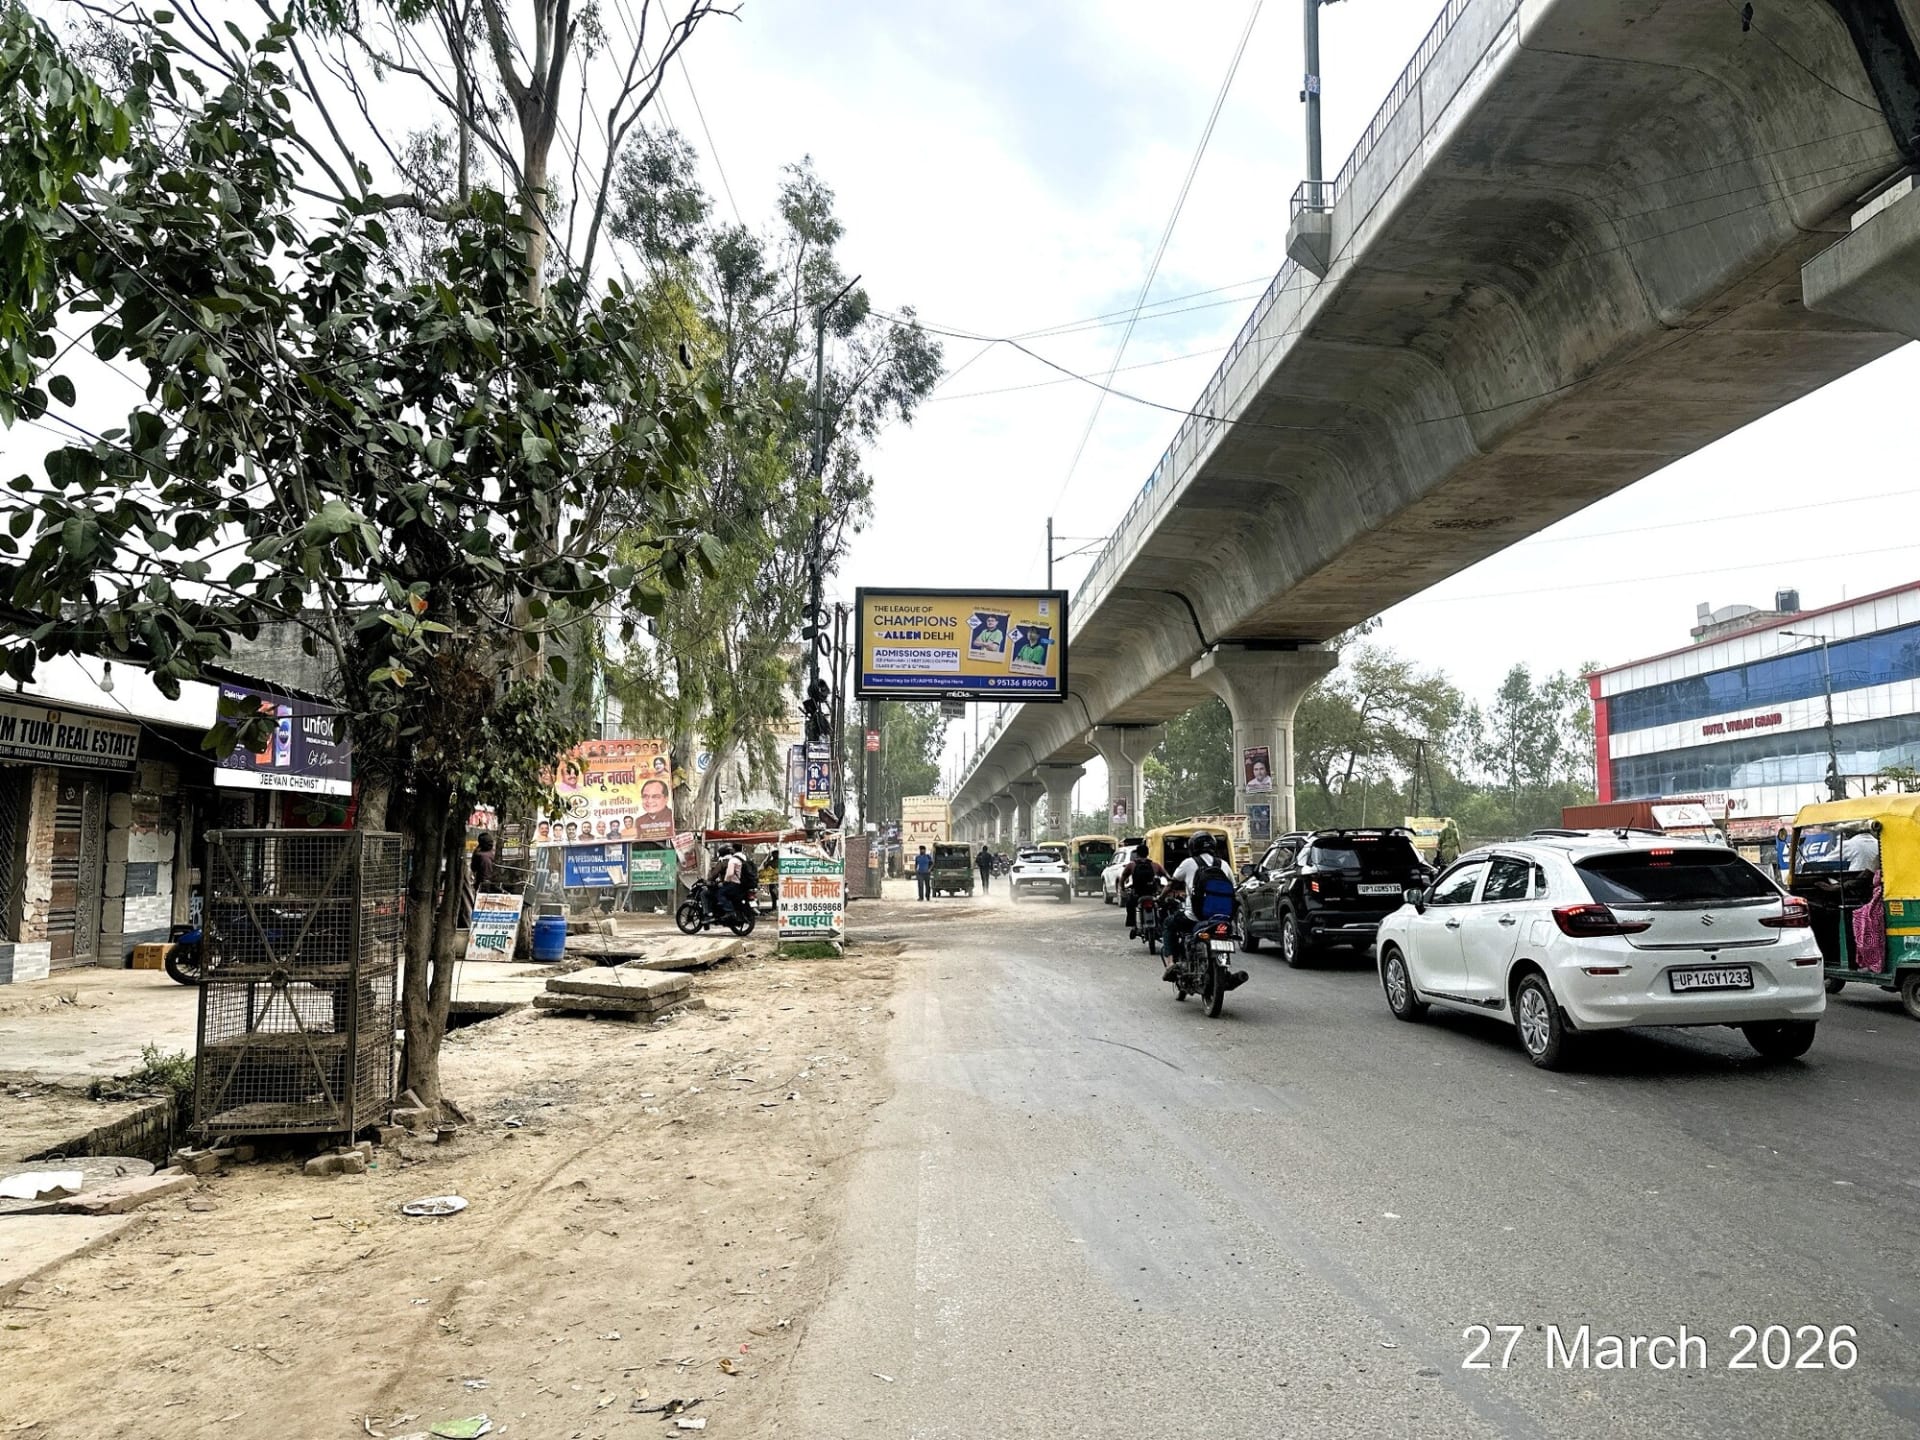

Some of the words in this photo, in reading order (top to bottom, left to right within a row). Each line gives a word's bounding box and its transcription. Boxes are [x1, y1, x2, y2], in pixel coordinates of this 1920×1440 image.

[889, 605, 920, 613] LEAGUE
[873, 615, 958, 627] CHAMPIONS
[884, 630, 922, 640] ALLEN
[923, 631, 954, 641] DELHI
[875, 649, 932, 658] ADMISSIONS
[933, 650, 958, 658] OPEN
[996, 679, 1020, 687] 95136
[0, 714, 17, 742] M
[20, 718, 54, 747] TUM
[56, 724, 89, 751] REAL
[92, 729, 136, 757] ESTATE
[260, 774, 288, 788] JEEVAN
[289, 777, 320, 790] CHEMIST
[911, 822, 938, 833] TLC
[781, 876, 809, 898] जीवन
[1679, 970, 1750, 986] UP14GV1233
